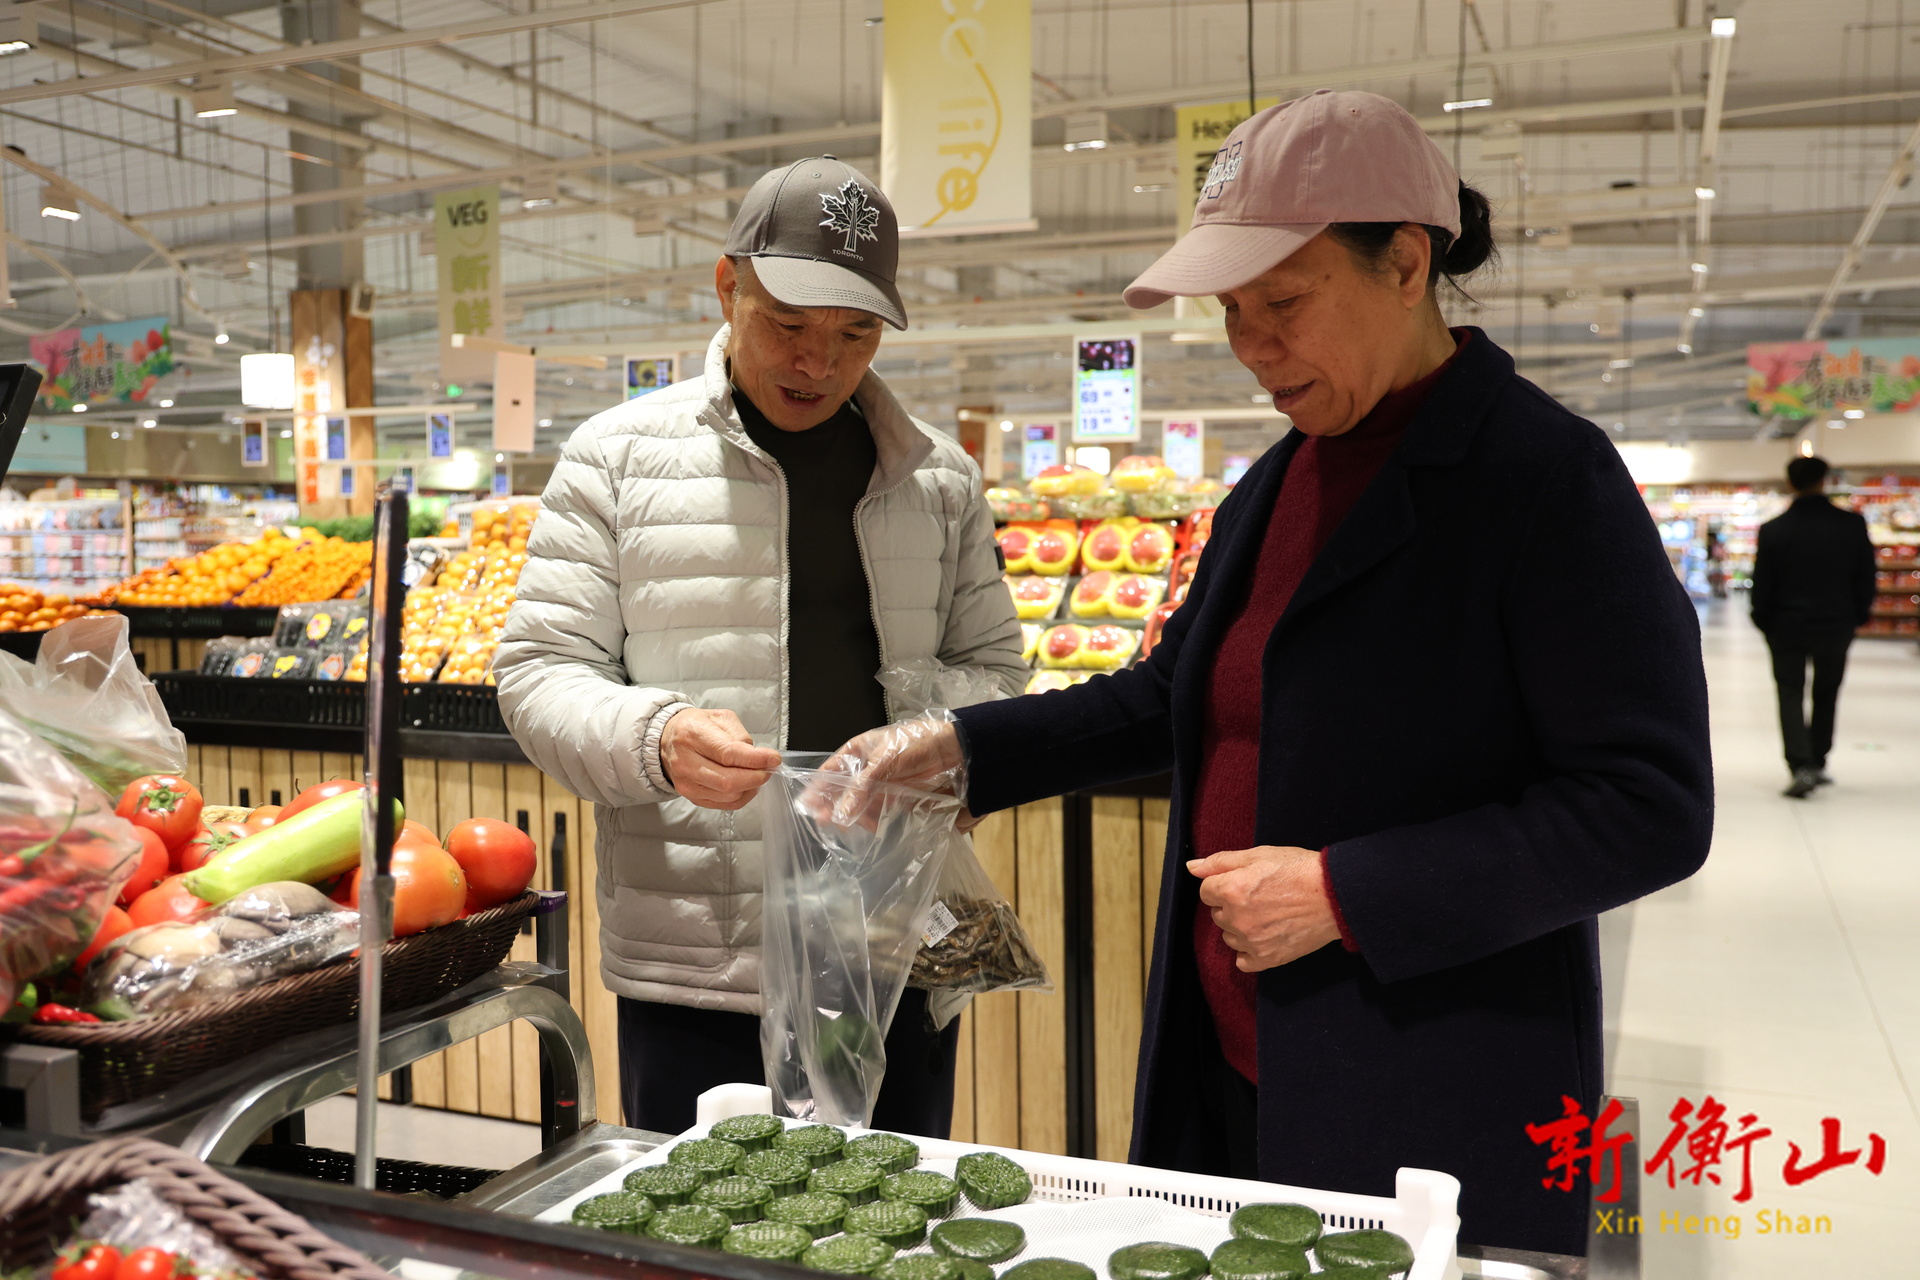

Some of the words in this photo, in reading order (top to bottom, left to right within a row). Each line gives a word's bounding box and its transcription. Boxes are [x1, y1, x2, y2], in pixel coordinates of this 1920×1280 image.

[937, 97, 992, 212] life
[447, 199, 489, 228] VEG
[832, 248, 864, 262] TORONTO
